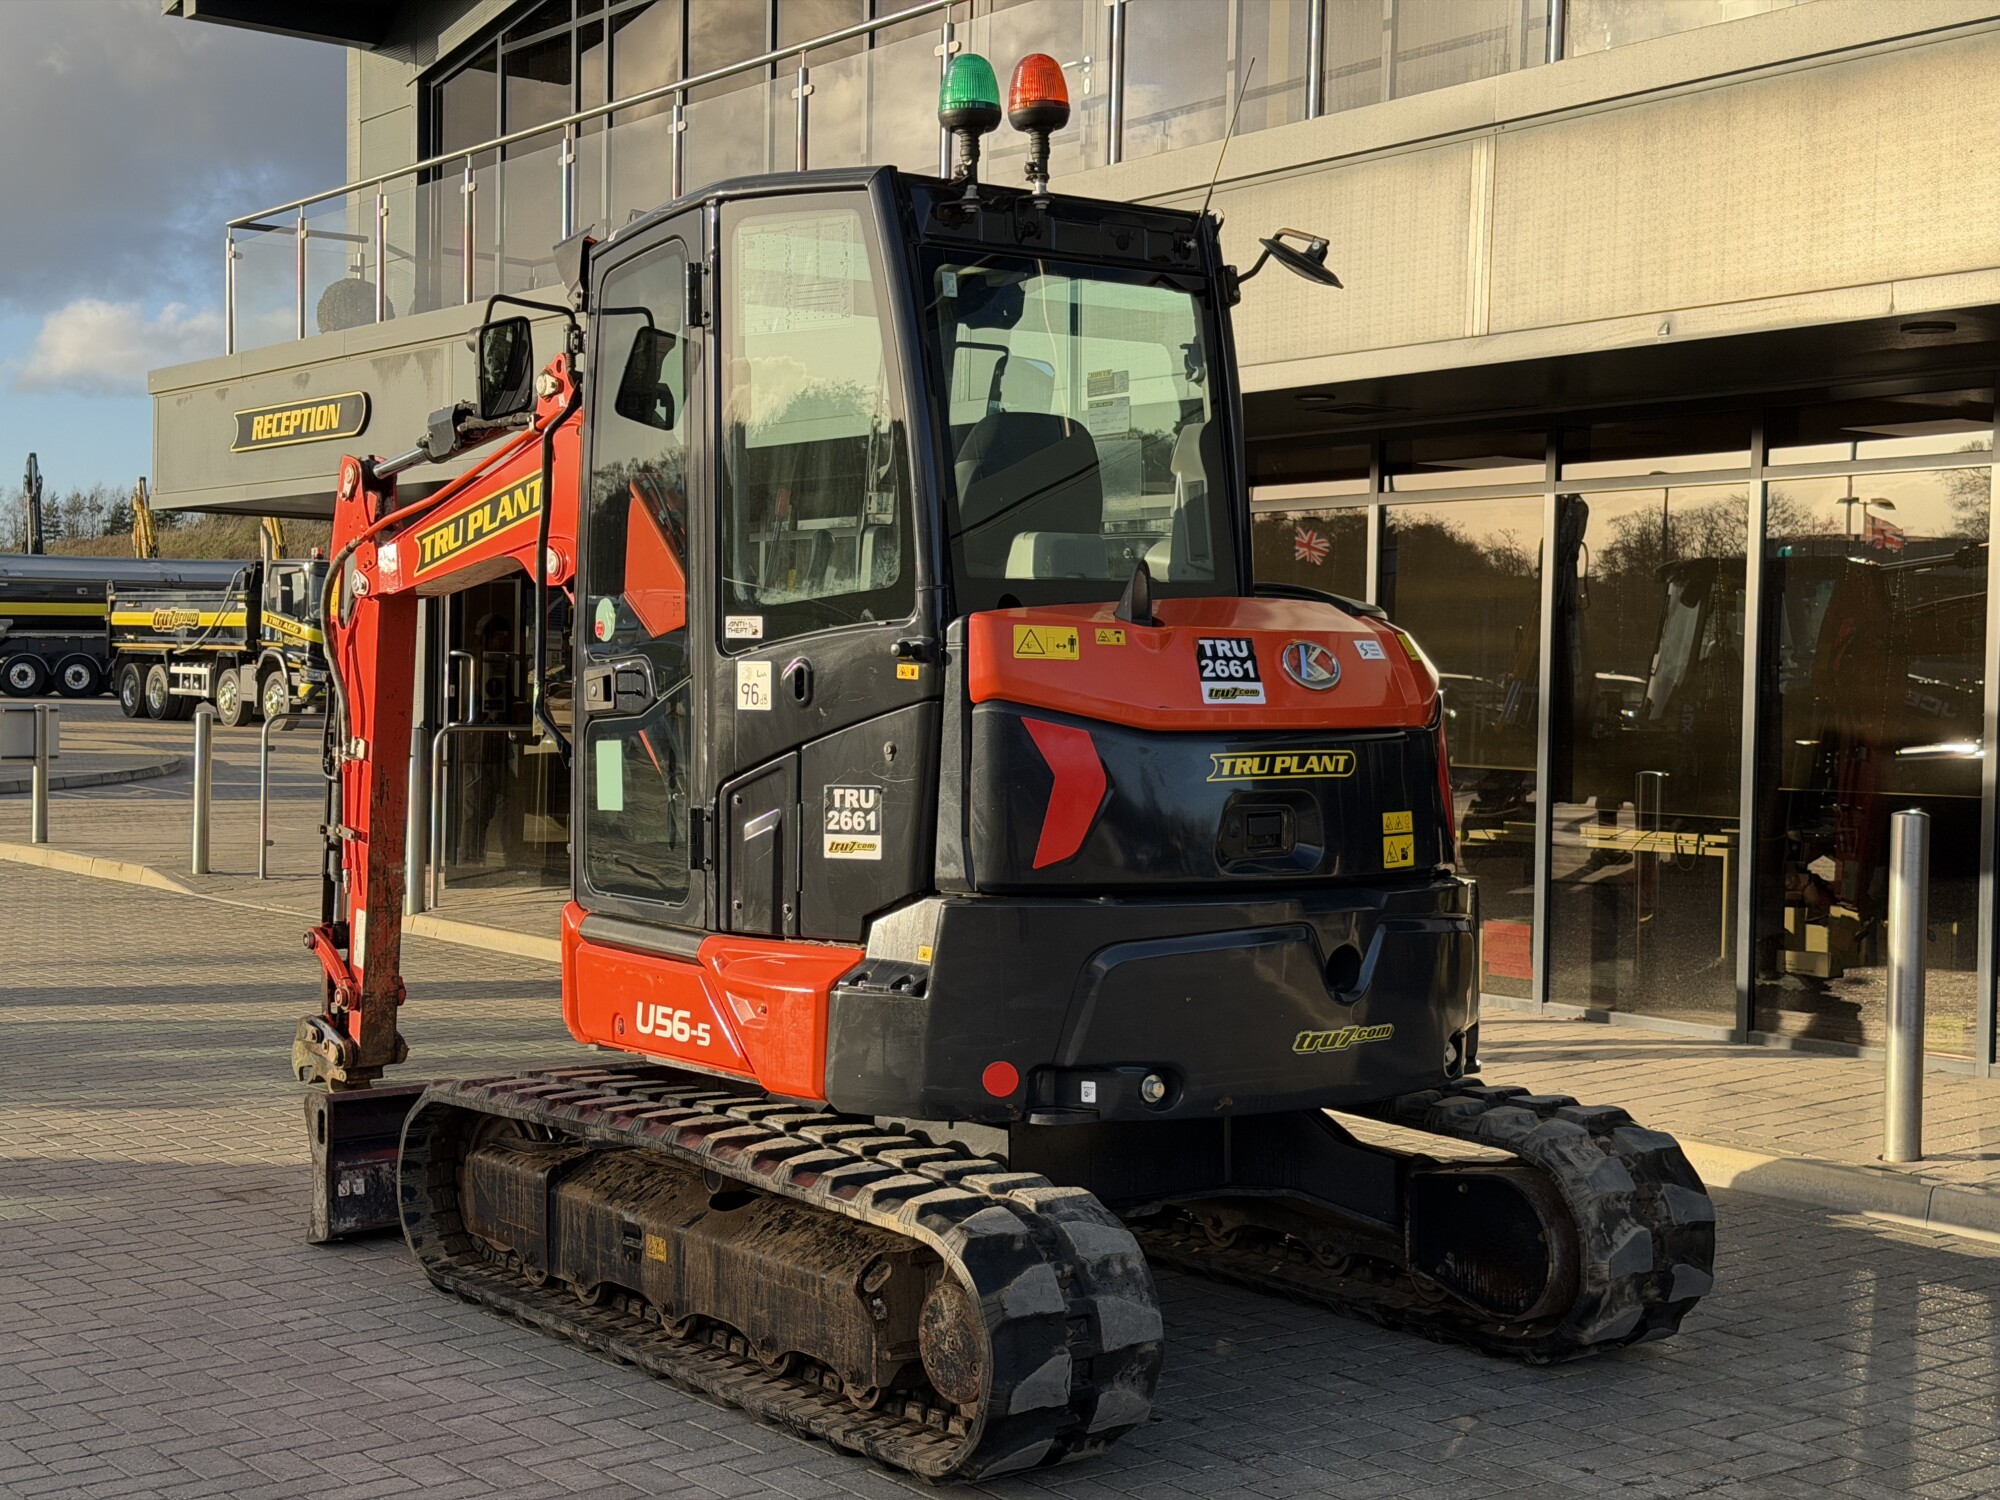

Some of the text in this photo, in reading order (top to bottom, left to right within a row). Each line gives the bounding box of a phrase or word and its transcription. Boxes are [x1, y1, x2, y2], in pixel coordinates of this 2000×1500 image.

[251, 403, 341, 441] RECEPTION
[422, 477, 542, 564] TRU PLANT
[1198, 639, 1249, 657] TRU
[1200, 659, 1255, 678] 2661
[741, 682, 759, 705] 96
[1220, 755, 1349, 776] TRU PLANT
[833, 788, 875, 808] TRU
[827, 810, 876, 831] 2661
[636, 1001, 711, 1047] U56-5
[1294, 1025, 1393, 1052] tru7.com
